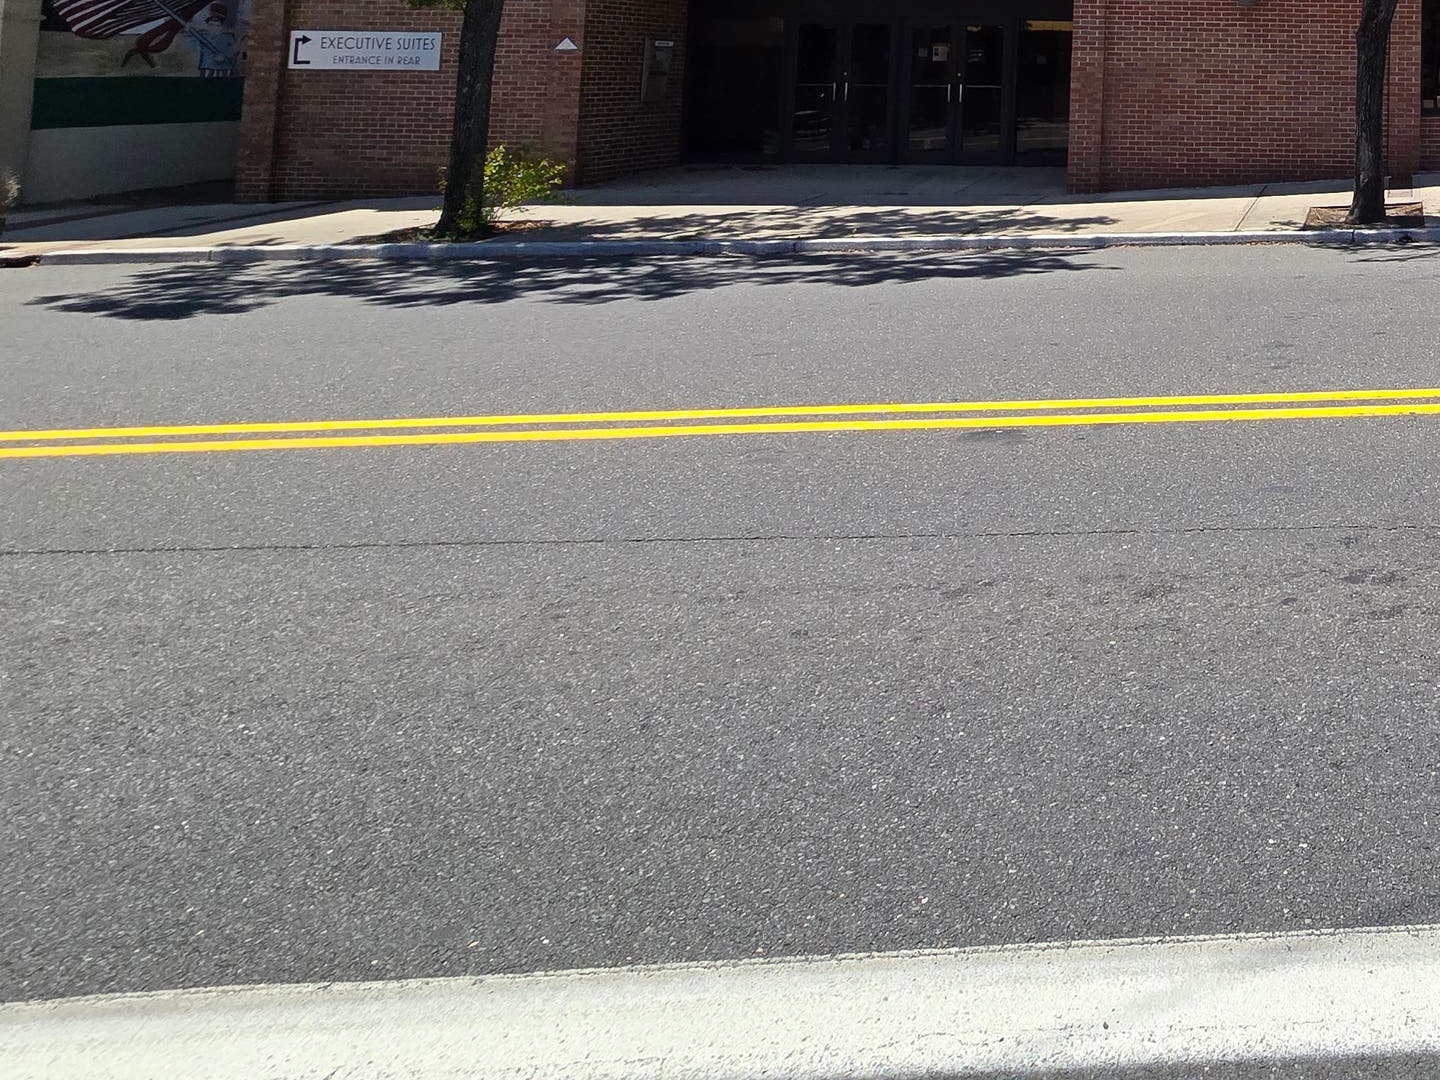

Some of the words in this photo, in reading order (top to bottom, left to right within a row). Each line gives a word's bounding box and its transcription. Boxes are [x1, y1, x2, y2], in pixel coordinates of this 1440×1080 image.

[320, 36, 393, 50] EXECUTIVE
[397, 37, 436, 51] SUITES
[332, 55, 381, 65] ENTRANCE
[384, 55, 394, 65] IN
[397, 55, 421, 65] REAR
